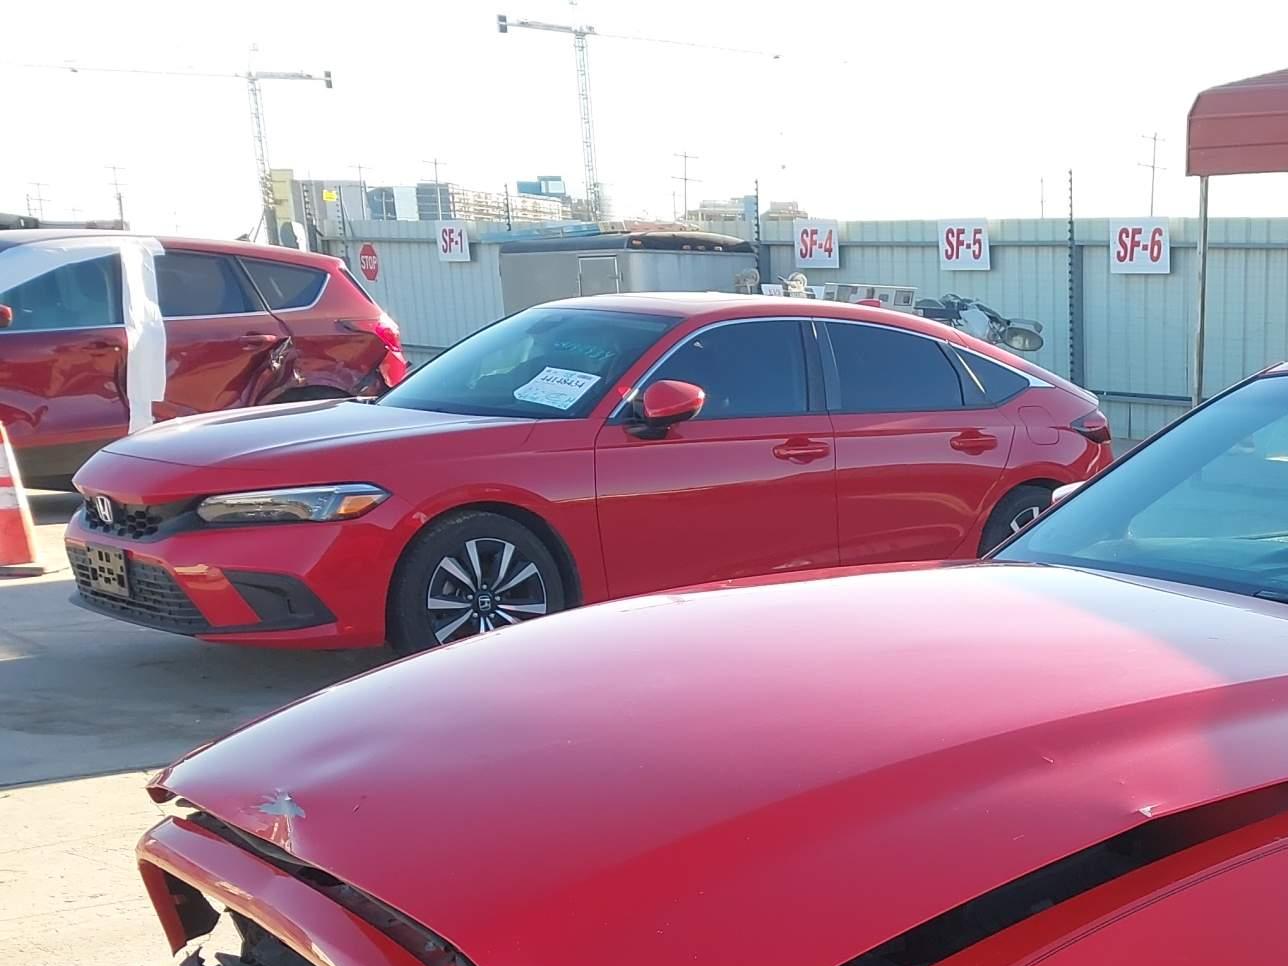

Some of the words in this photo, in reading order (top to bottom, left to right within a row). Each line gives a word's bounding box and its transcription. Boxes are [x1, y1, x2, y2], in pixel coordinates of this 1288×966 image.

[441, 228, 464, 253] SF-1
[799, 228, 833, 259] SF-4
[944, 227, 983, 261] SF-5
[1116, 227, 1164, 263] SF-6
[361, 255, 377, 270] STOP
